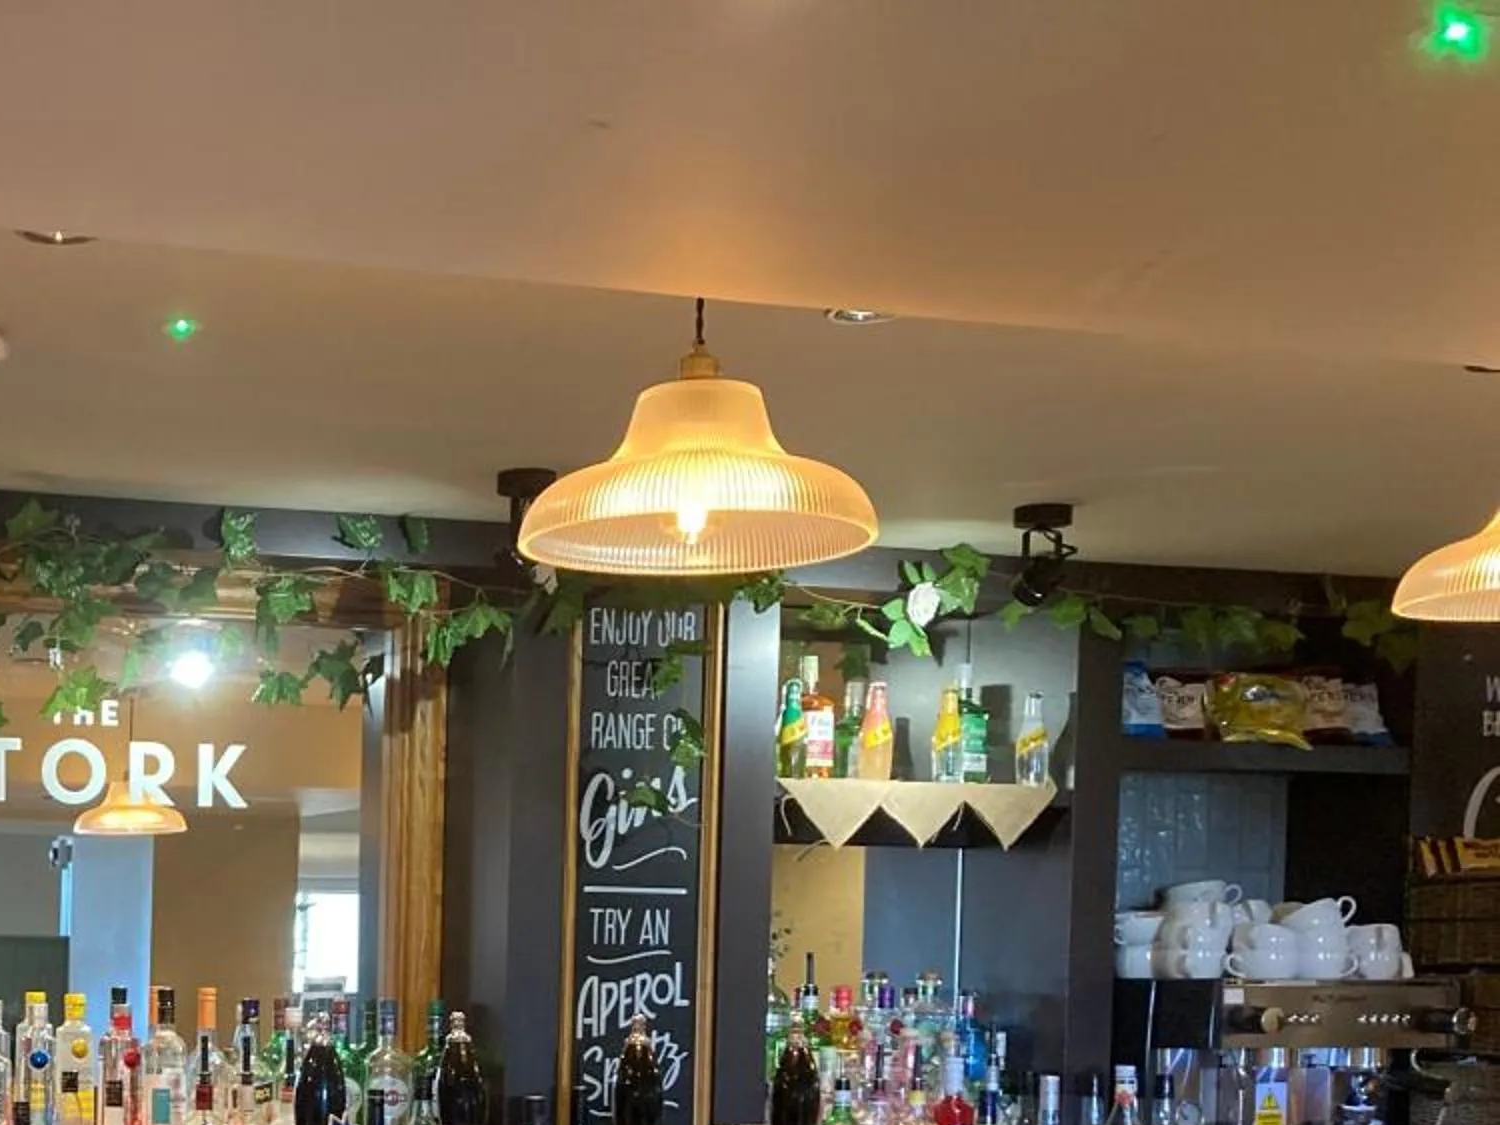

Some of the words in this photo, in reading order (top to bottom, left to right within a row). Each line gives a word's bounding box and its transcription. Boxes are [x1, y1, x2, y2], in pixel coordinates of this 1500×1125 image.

[589, 607, 652, 647] ENJOY
[606, 660, 660, 700] GREA
[590, 711, 656, 750] RANGE
[589, 908, 632, 945] TRY
[638, 909, 670, 945] AN
[576, 960, 690, 1040] APEROL
